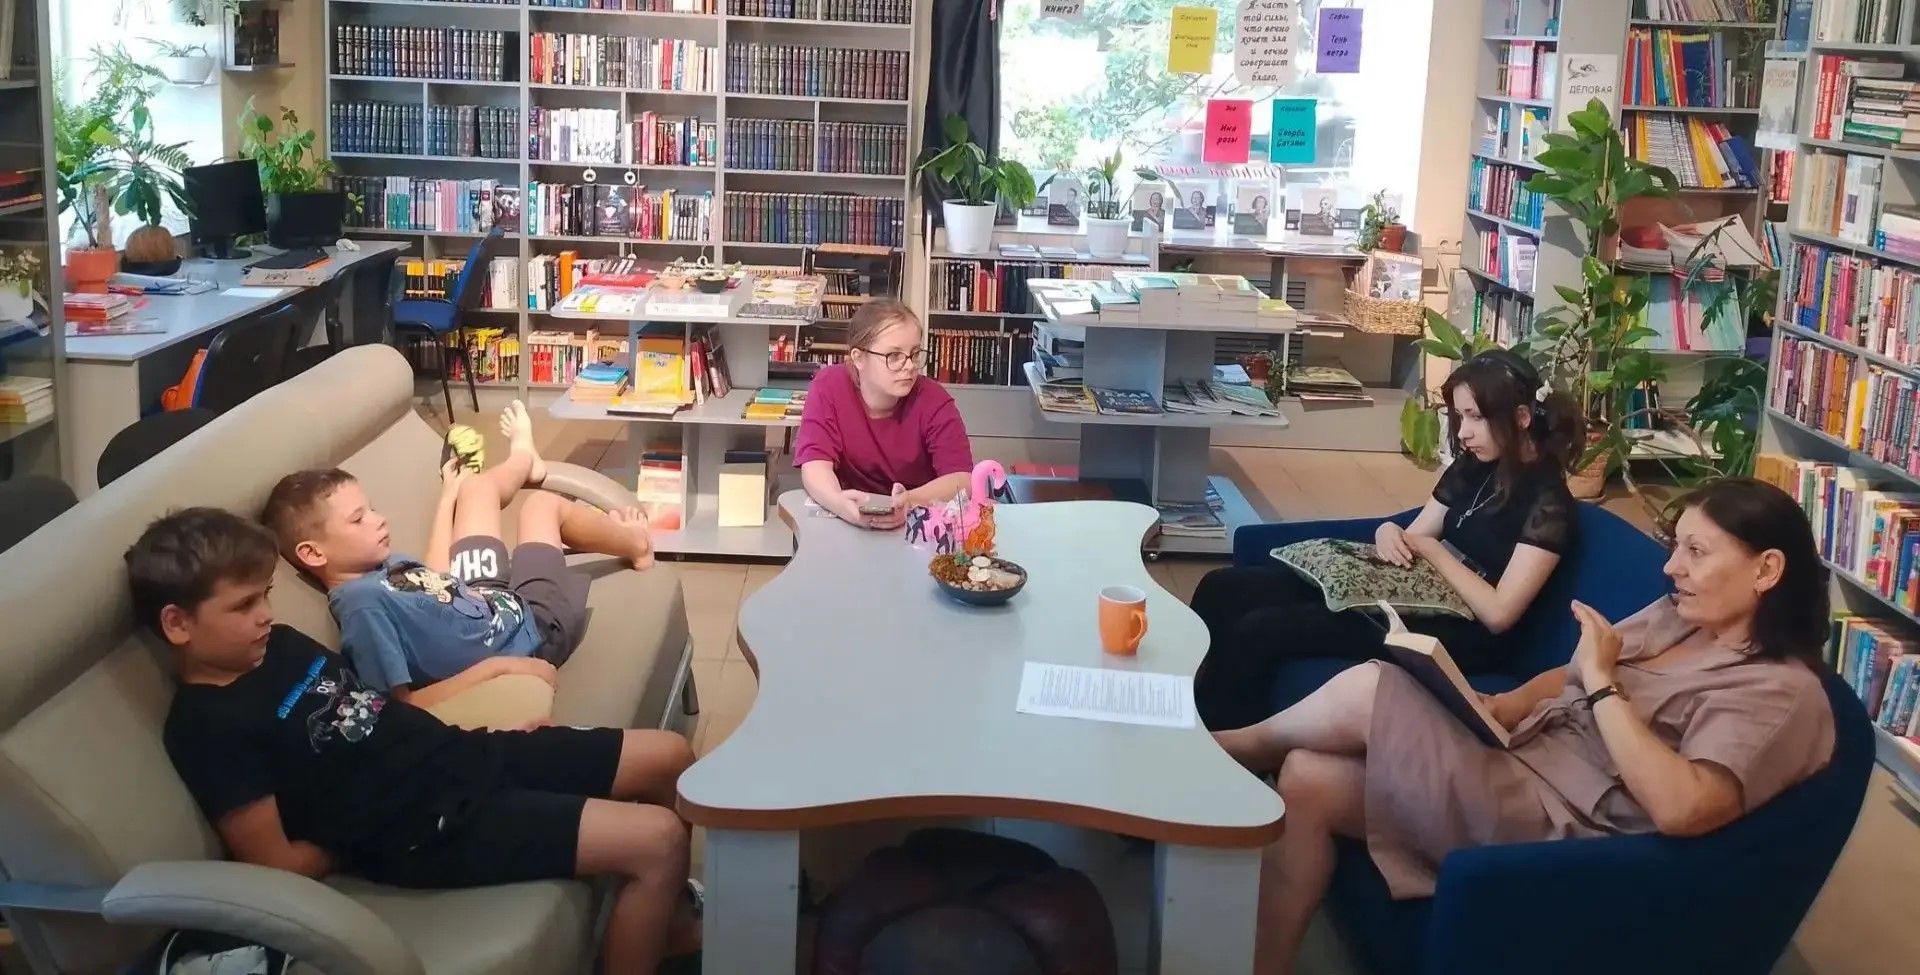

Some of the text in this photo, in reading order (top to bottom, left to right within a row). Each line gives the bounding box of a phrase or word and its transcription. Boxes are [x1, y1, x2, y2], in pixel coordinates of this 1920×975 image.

[1243, 12, 1262, 21] той
[1244, 25, 1290, 33] что вечно
[1240, 36, 1268, 46] хочет
[1263, 47, 1289, 55] вечно
[1240, 59, 1288, 69] совершает
